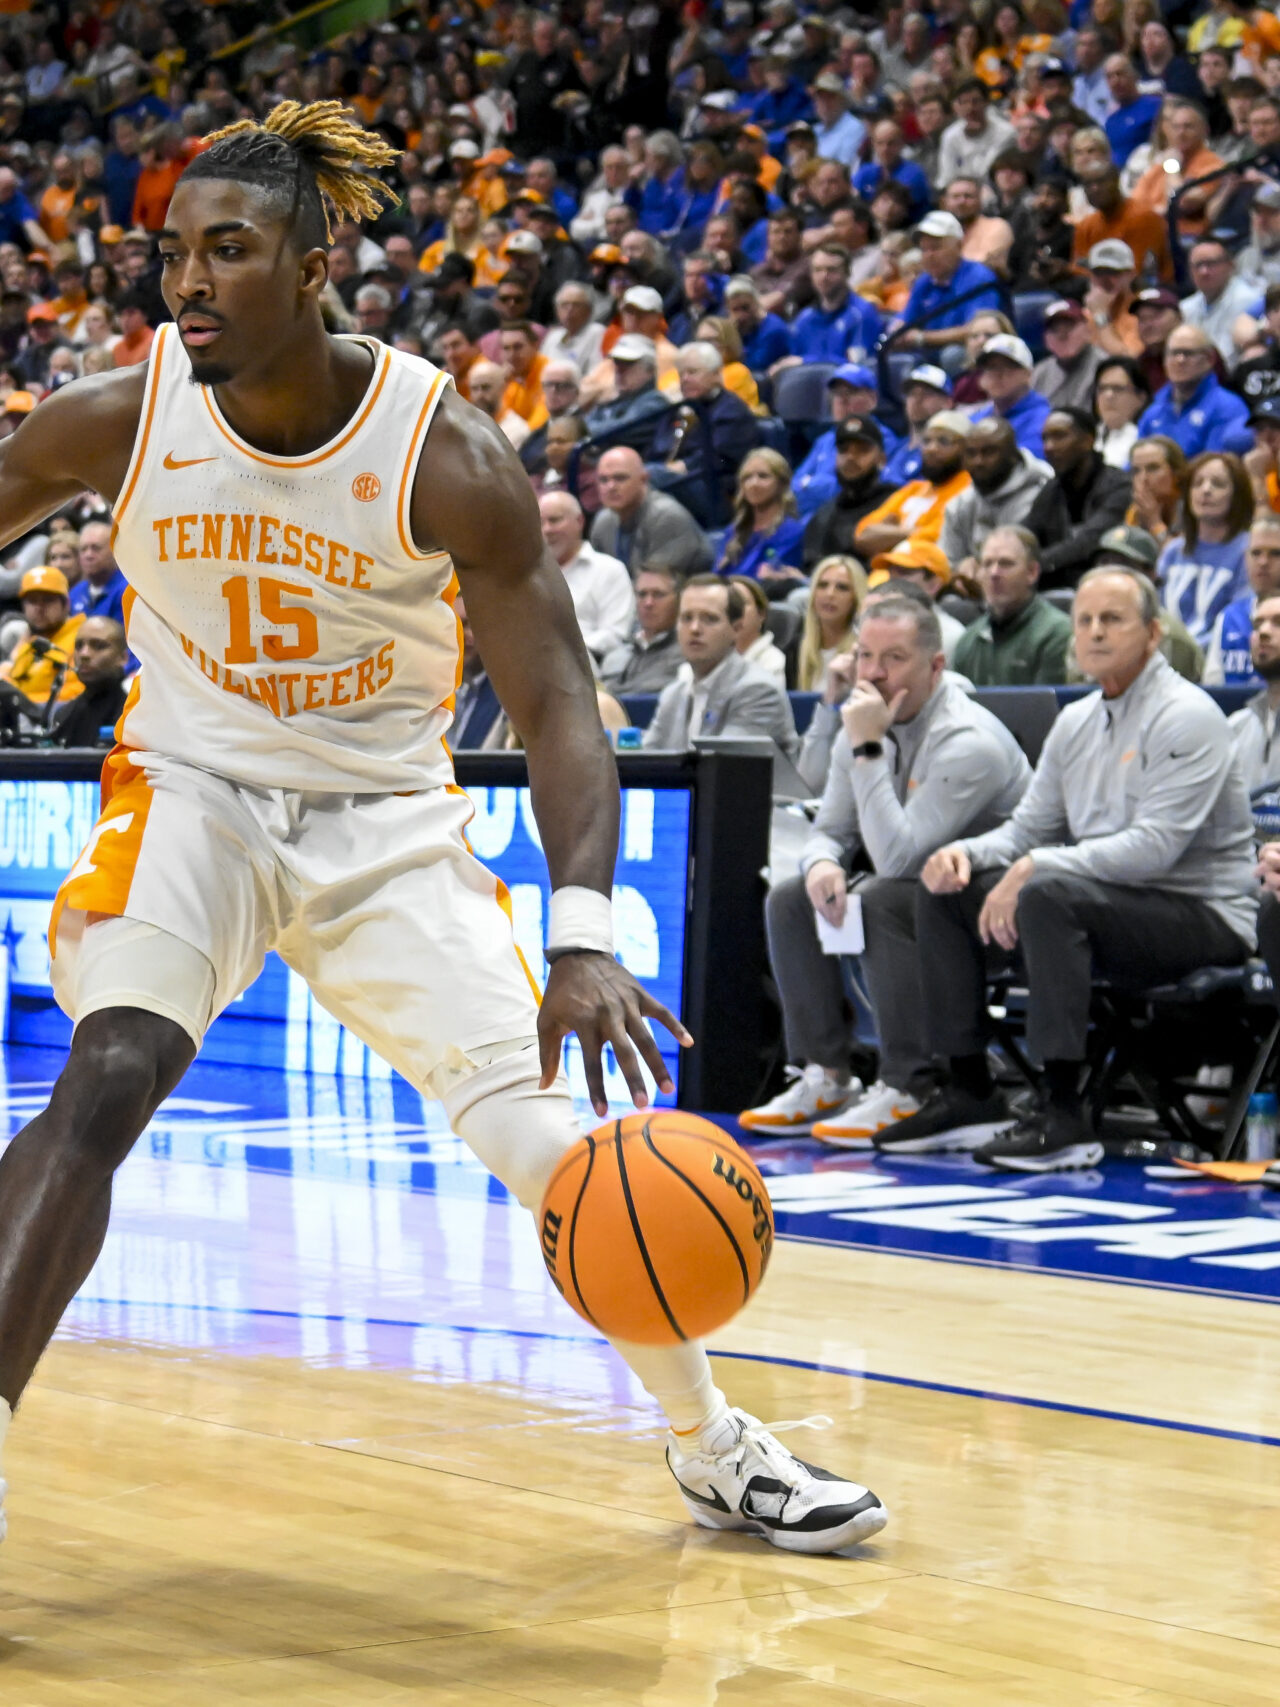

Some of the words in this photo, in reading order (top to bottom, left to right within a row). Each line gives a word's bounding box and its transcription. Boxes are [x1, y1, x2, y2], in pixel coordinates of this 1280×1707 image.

[355, 475, 380, 499] SEC
[152, 514, 374, 589] TENNESSEE
[222, 576, 319, 664] 15
[768, 1170, 1280, 1270] MEA
